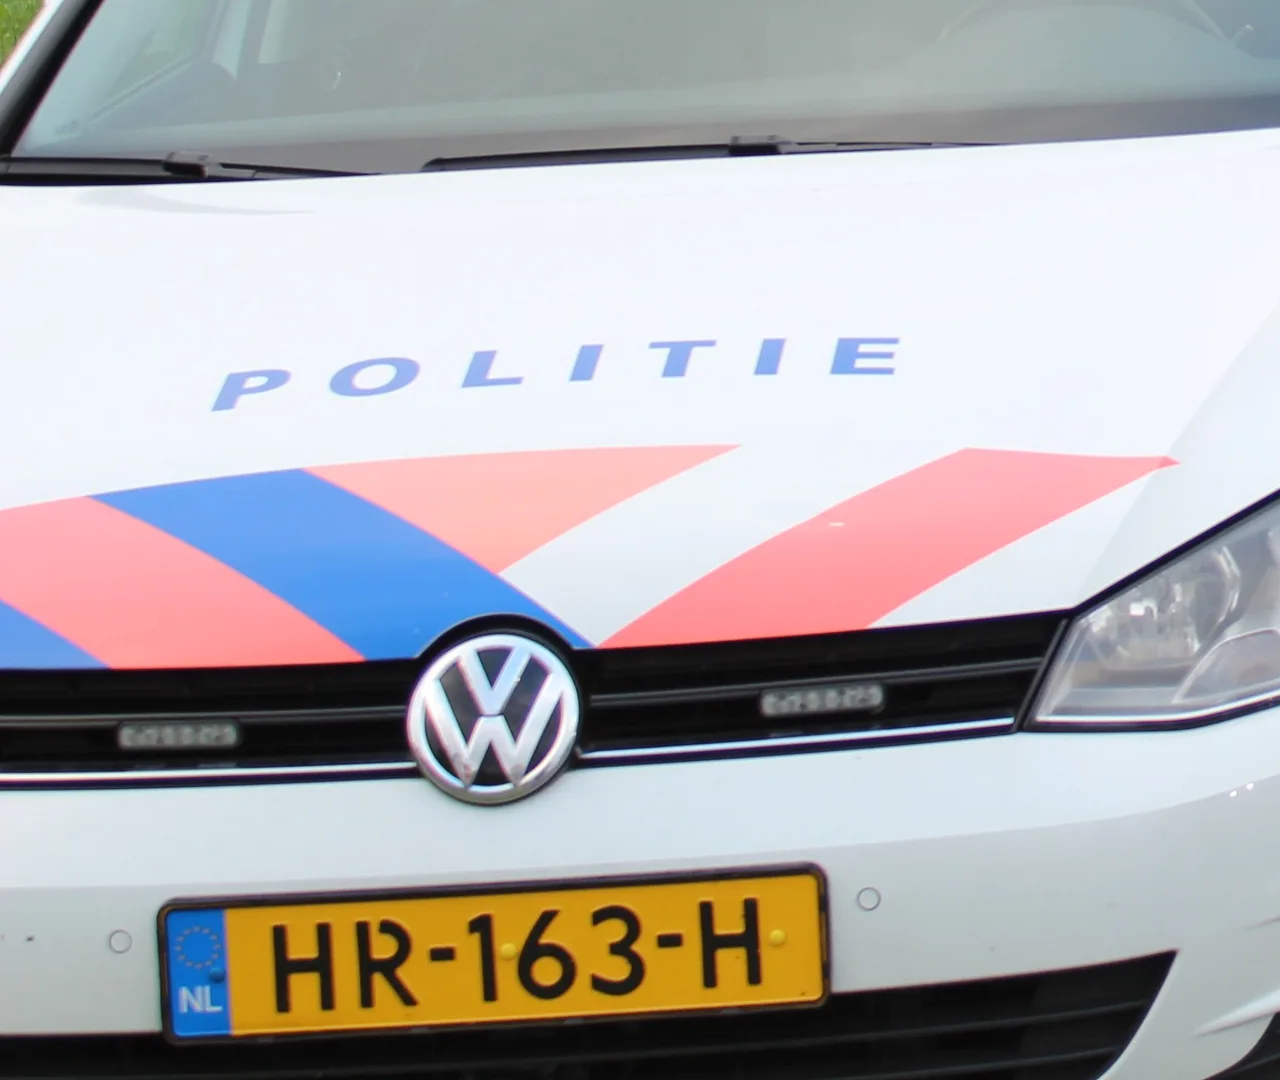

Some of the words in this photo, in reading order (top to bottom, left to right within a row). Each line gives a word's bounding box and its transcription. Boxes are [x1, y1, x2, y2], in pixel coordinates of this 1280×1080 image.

[210, 336, 902, 413] POLITIE
[177, 984, 224, 1015] NL
[271, 895, 763, 1015] HR-163-H
